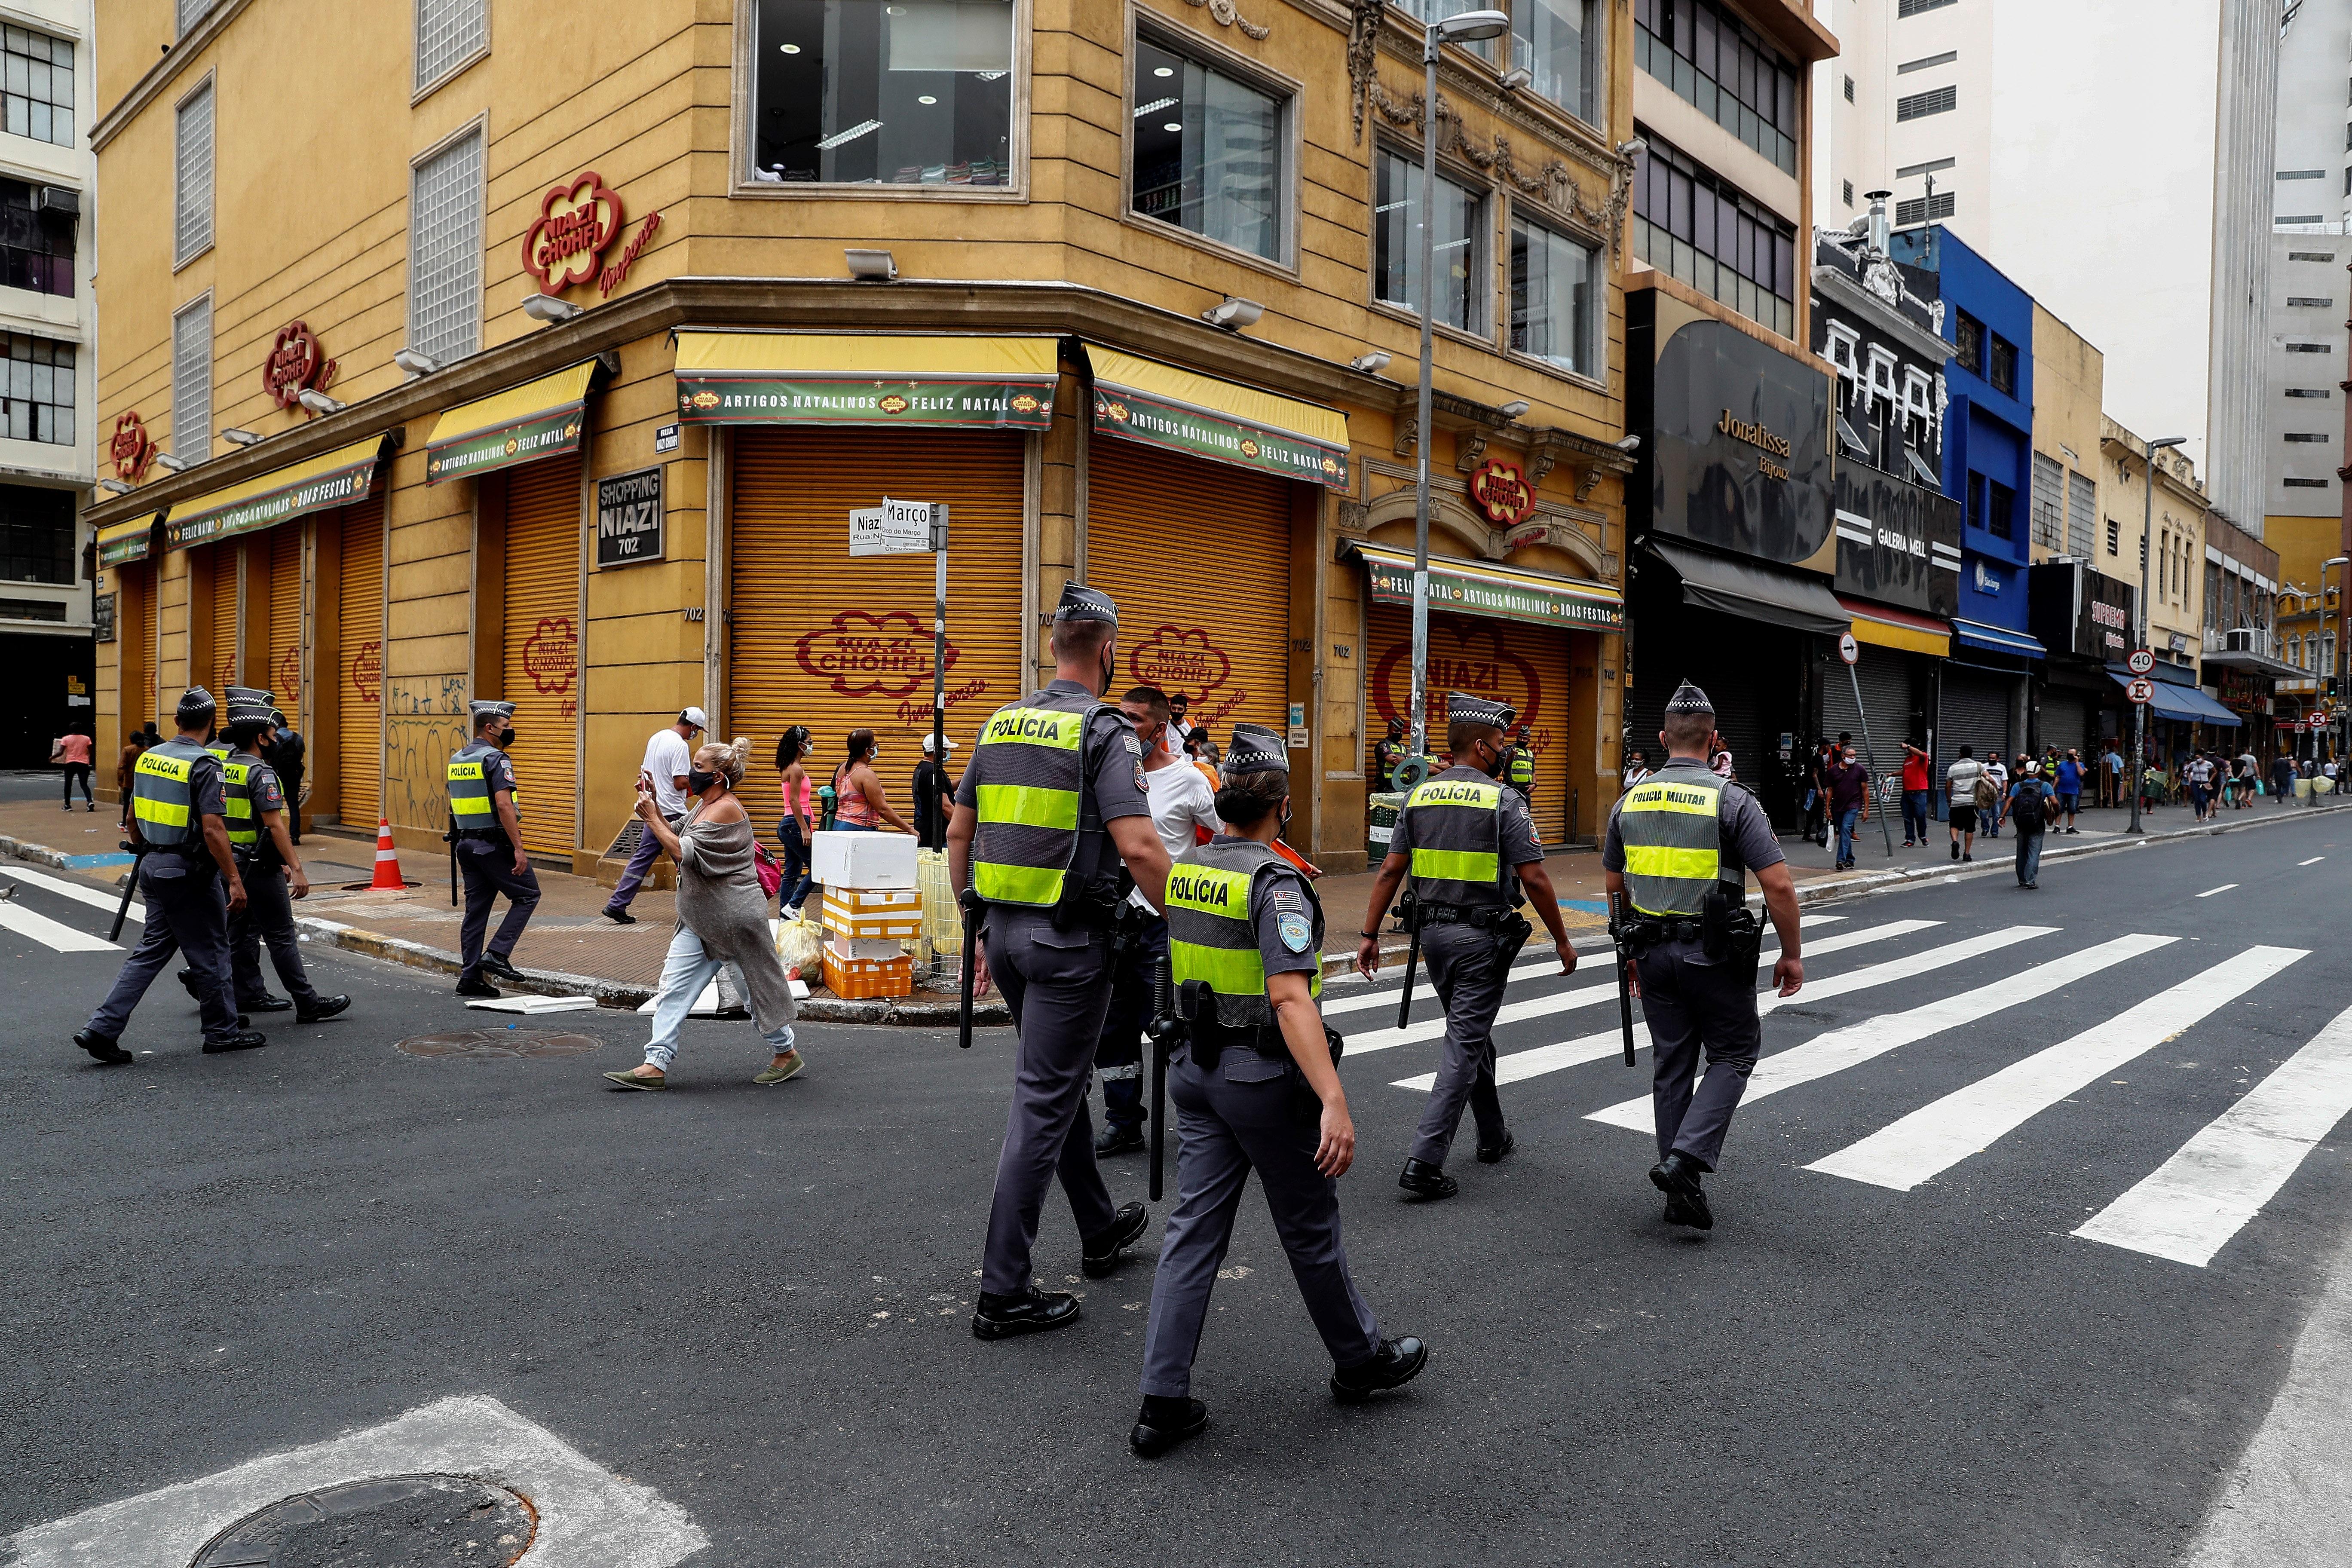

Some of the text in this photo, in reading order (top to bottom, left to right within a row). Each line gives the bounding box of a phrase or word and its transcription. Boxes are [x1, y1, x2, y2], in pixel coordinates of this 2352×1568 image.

[545, 201, 597, 242] NIAZI
[538, 222, 603, 266] CHOHFI
[724, 395, 876, 408] ARTIGOS NATALINOS
[912, 397, 1008, 411] FELIZ NATAL
[518, 429, 564, 451] FELIZ NATAL
[660, 427, 674, 437] RUA
[1131, 412, 1238, 450] ARTIGOS NATALINOS
[1718, 408, 1790, 458] Jonalissa
[441, 444, 504, 472] ARTIGOS NATALINOS
[1262, 444, 1323, 470] FELIZ NATAL
[1758, 456, 1789, 481] Bijoux
[319, 477, 351, 502] FESTAS
[601, 474, 659, 505] SHOPPING
[1486, 474, 1521, 493] NIAZI
[1480, 487, 1525, 509] CHOHFI
[600, 500, 659, 538] NIAZI
[858, 515, 881, 531] Niazi
[888, 504, 927, 526] Março
[182, 523, 197, 540] FELIZ
[618, 536, 640, 555] 702
[1878, 528, 1926, 558] GALERIA MELL
[1391, 577, 1453, 600] FELI ATAL
[1464, 588, 1550, 615] ARTIGOS NATALINOS
[684, 607, 702, 620] 702
[1561, 603, 1611, 622] BOAS FESTAS
[2092, 600, 2125, 630] SUPREMA
[539, 641, 568, 655] NIAZI
[836, 637, 916, 653] NIAZI
[1293, 639, 1311, 651] 702
[1334, 645, 1351, 658] 702
[532, 656, 574, 671] CHOHFI
[820, 654, 925, 671] CHOHFI
[1158, 651, 1205, 666] NIAZI
[2132, 655, 2150, 665] 40
[1145, 665, 1212, 682] CHOHFI
[1426, 658, 1499, 689] NIAZI
[990, 714, 1058, 740] POLÍCIA
[142, 757, 178, 775] POLÍCIA
[451, 763, 476, 777] POLÍCIA
[1421, 785, 1480, 802] POLÍCIA
[1633, 790, 1706, 805] POLICIA MILITAR
[1170, 874, 1228, 906] POLÍCIA
